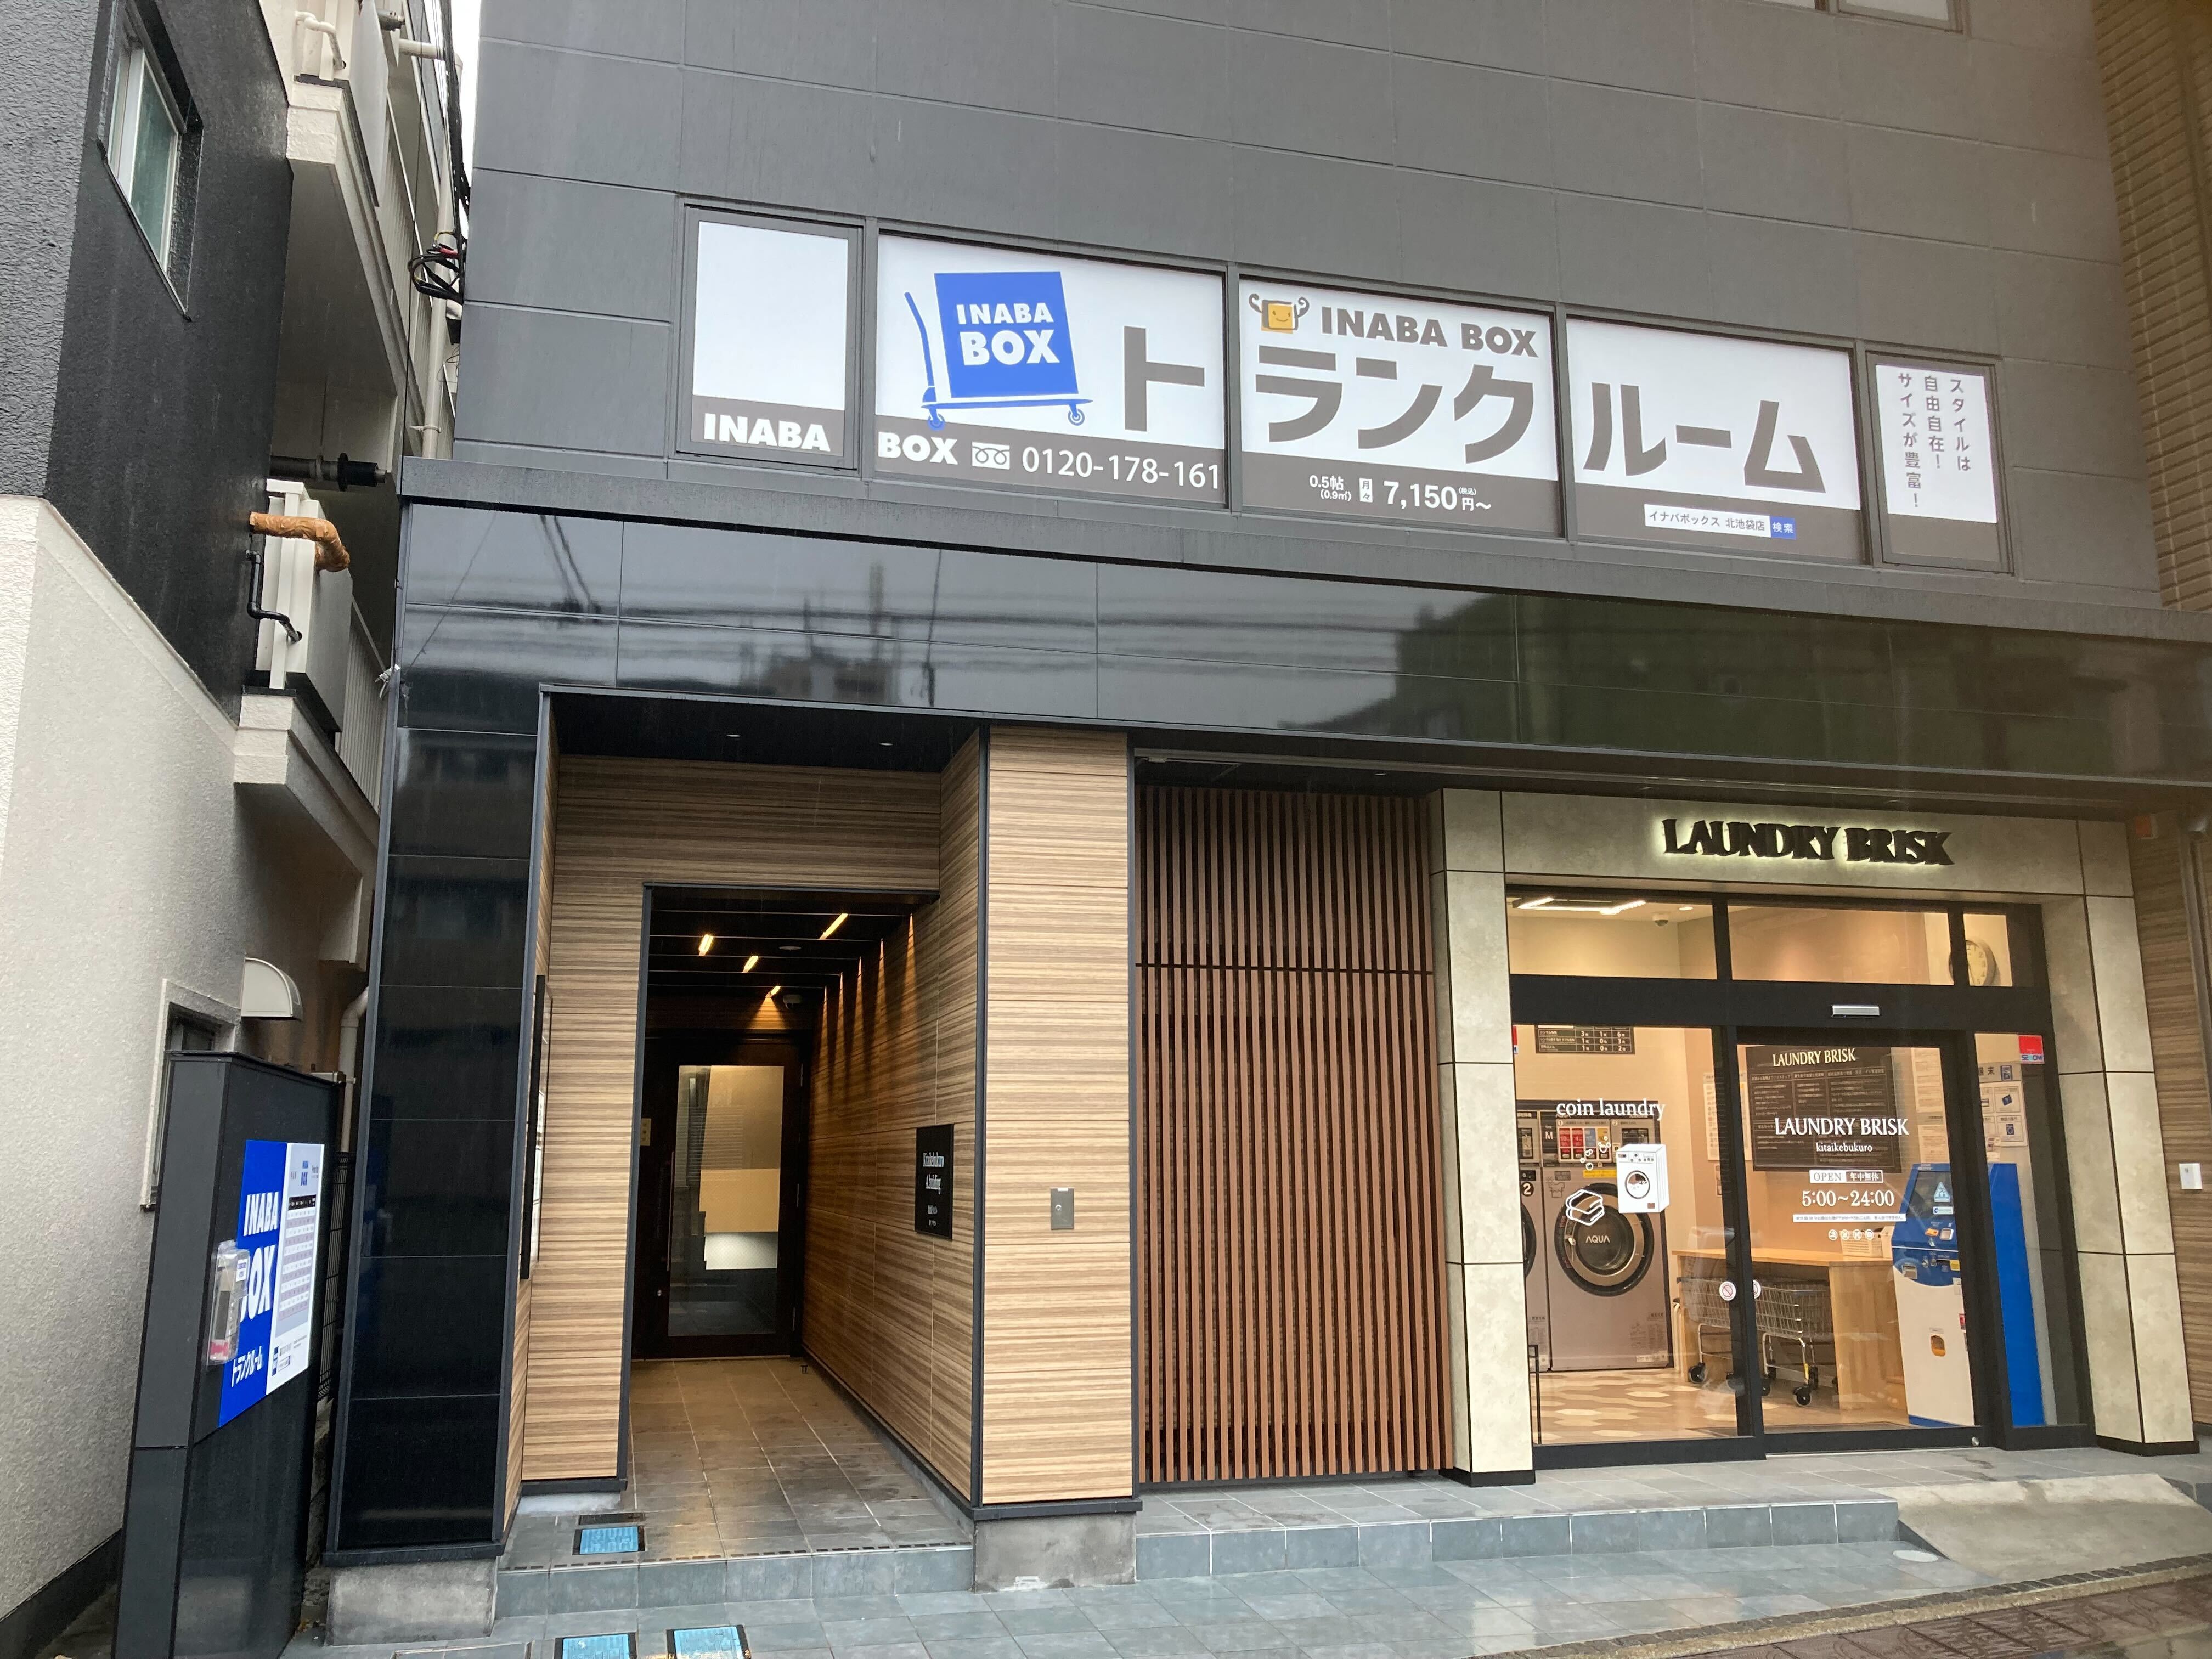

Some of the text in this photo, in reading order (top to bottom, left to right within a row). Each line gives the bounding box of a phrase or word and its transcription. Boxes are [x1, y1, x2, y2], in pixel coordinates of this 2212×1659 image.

[956, 303, 1054, 324] INABA
[1321, 306, 1539, 358] INABA BOX
[960, 330, 1060, 366] BOX
[1950, 379, 1971, 471] スタイルは
[704, 413, 1220, 489] INABA BOX 0120-178-161
[1649, 511, 1765, 531] イナバボックス 北池袋店
[1772, 522, 1795, 534] 検索
[1662, 819, 1955, 865] LAUNDRY BRISK
[1773, 1048, 1856, 1067] LAUNDRY BRISK
[1556, 1098, 1666, 1121] coin laundry
[1545, 1131, 1553, 1141] M
[1774, 1117, 1910, 1135] LAUNDRY BRISK
[1816, 1142, 1873, 1153] kitaikebukuro
[1813, 1172, 1842, 1181] OPEN
[1850, 1172, 1879, 1181] 年中無休
[1523, 1183, 1531, 1195] 2
[243, 1191, 280, 1237] INABA
[1585, 1235, 1610, 1243] AQUA
[240, 1245, 276, 1323] OX
